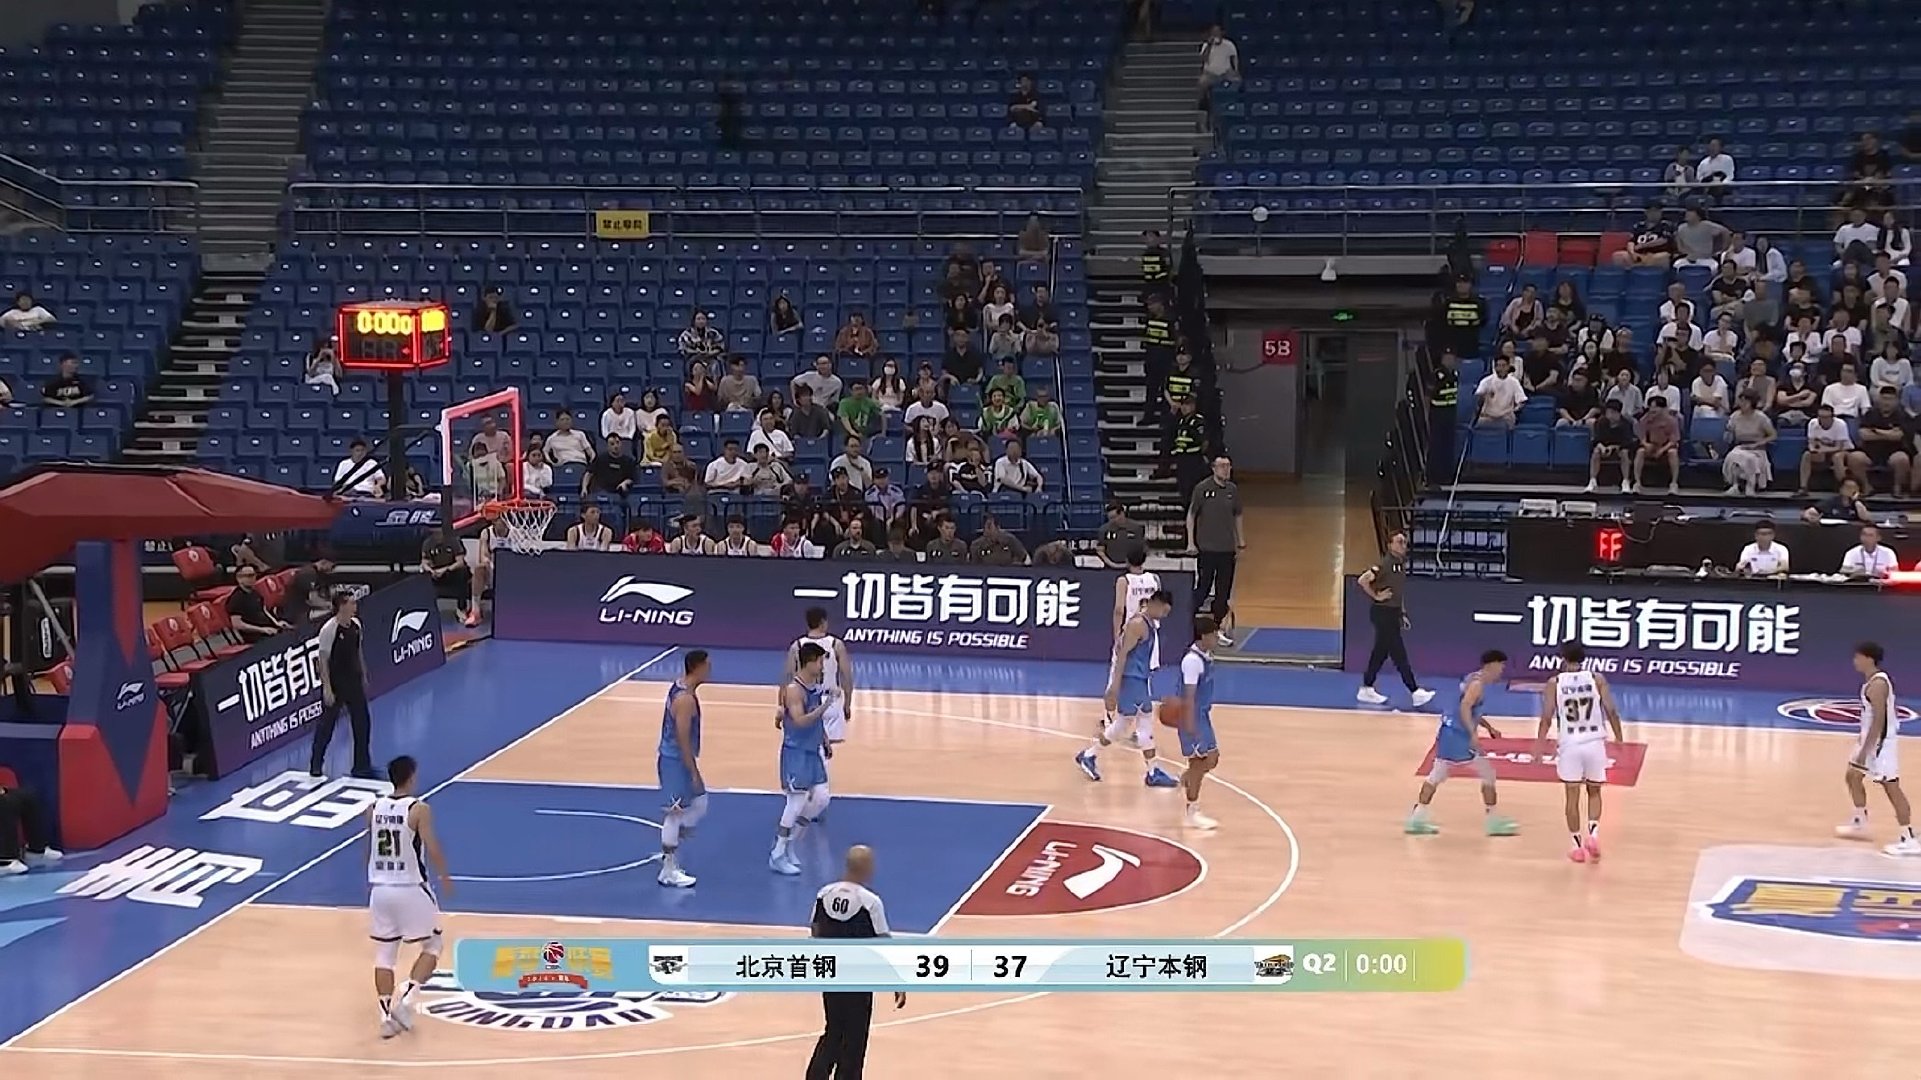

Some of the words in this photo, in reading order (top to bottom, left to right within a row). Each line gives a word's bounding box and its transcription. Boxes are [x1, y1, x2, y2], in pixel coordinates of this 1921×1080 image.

[1265, 340, 1290, 356] 5B
[794, 572, 1080, 627] 一切皆有可能
[599, 607, 695, 626] LI-NING
[1473, 595, 1800, 655] 一切皆有可能
[393, 634, 433, 664] LI-NING
[843, 628, 922, 645] ANYTHING
[927, 631, 943, 646] IS
[948, 632, 1029, 650] POSSIBLE
[217, 636, 322, 721] 一切皆有可
[1528, 655, 1619, 673] ANYHING
[1623, 659, 1643, 674] IS
[1647, 660, 1742, 678] POSSIBLE
[1564, 697, 1594, 722] 37
[377, 829, 401, 857] 21
[1006, 840, 1077, 897] LI-NING
[832, 896, 849, 915] 60
